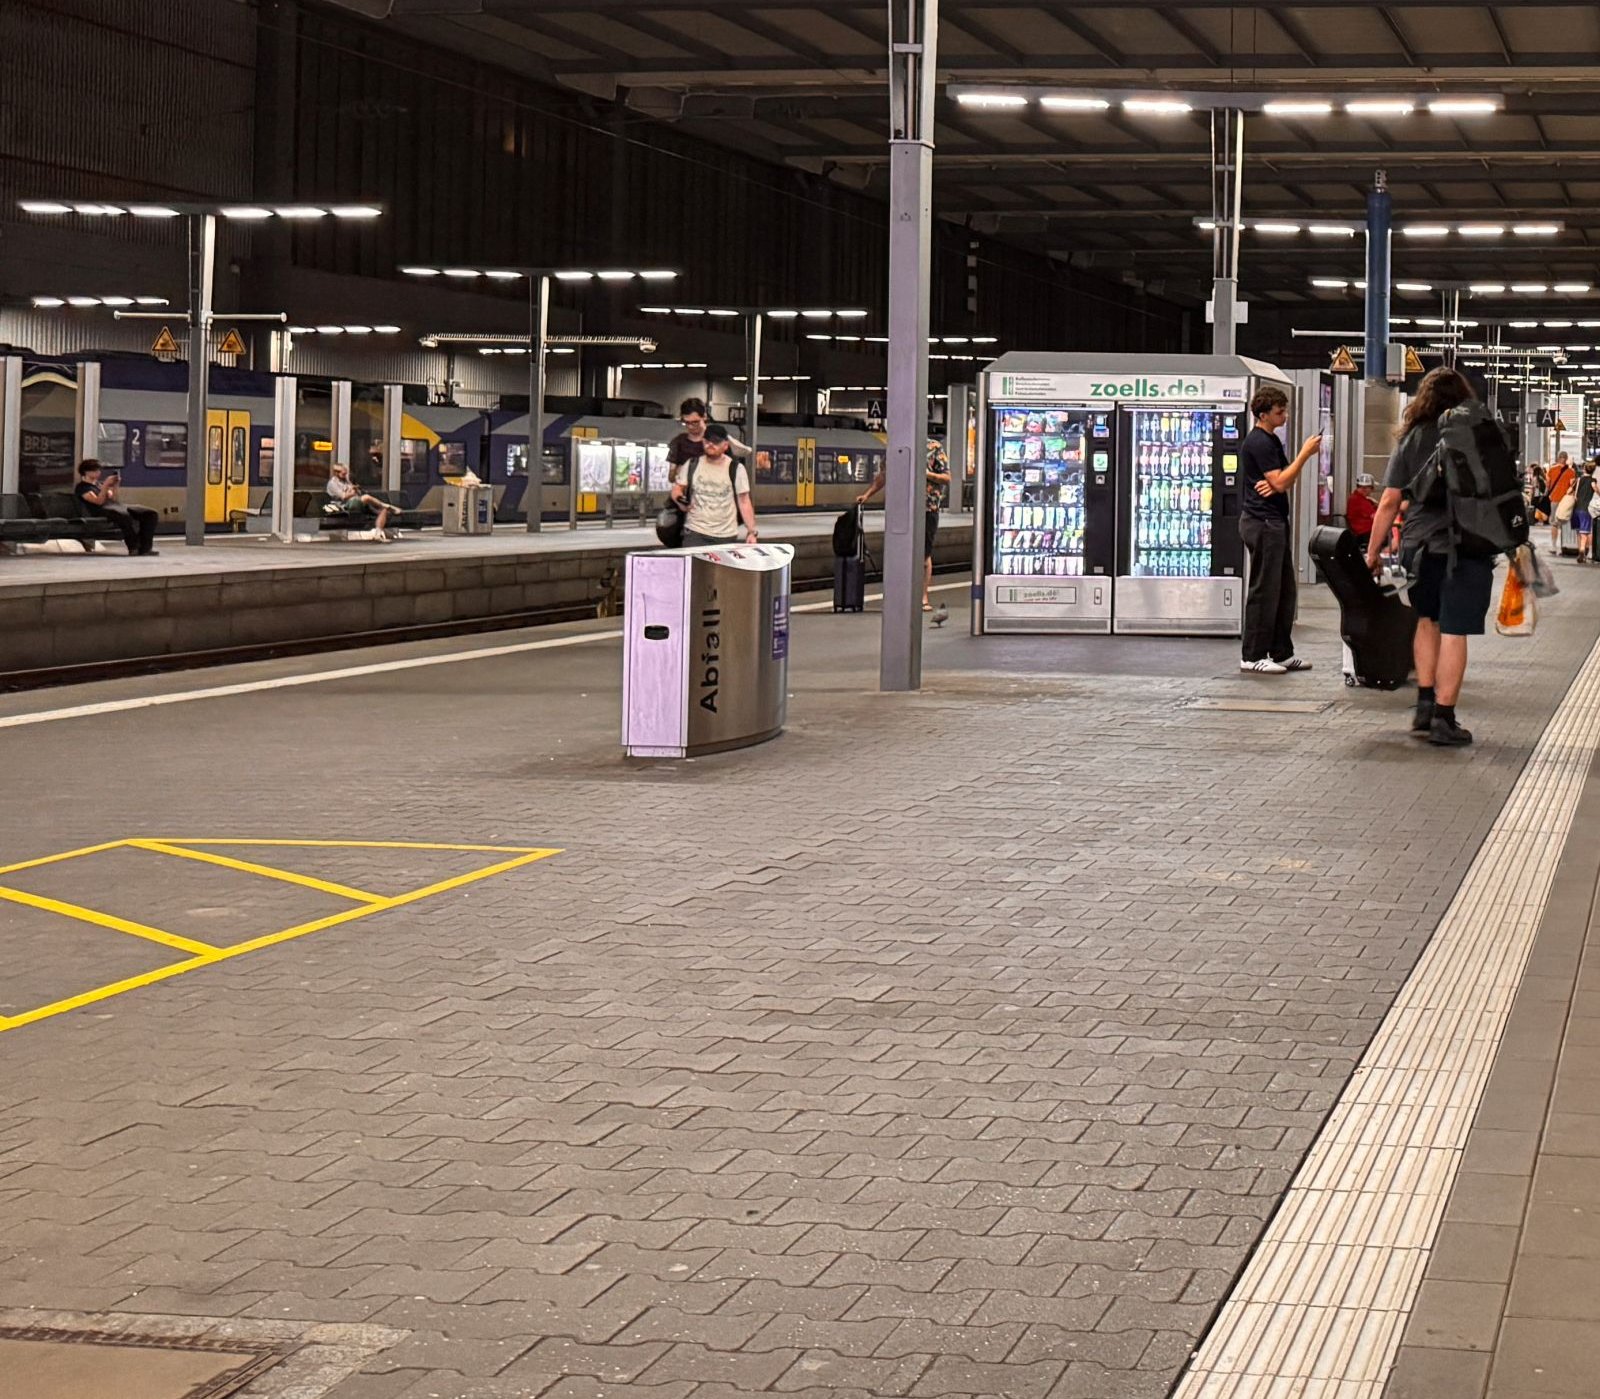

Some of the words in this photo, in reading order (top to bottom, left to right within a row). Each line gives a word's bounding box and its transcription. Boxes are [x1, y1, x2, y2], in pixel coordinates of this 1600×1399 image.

[870, 401, 881, 415] A
[1542, 410, 1553, 424] A
[132, 428, 140, 445] 2
